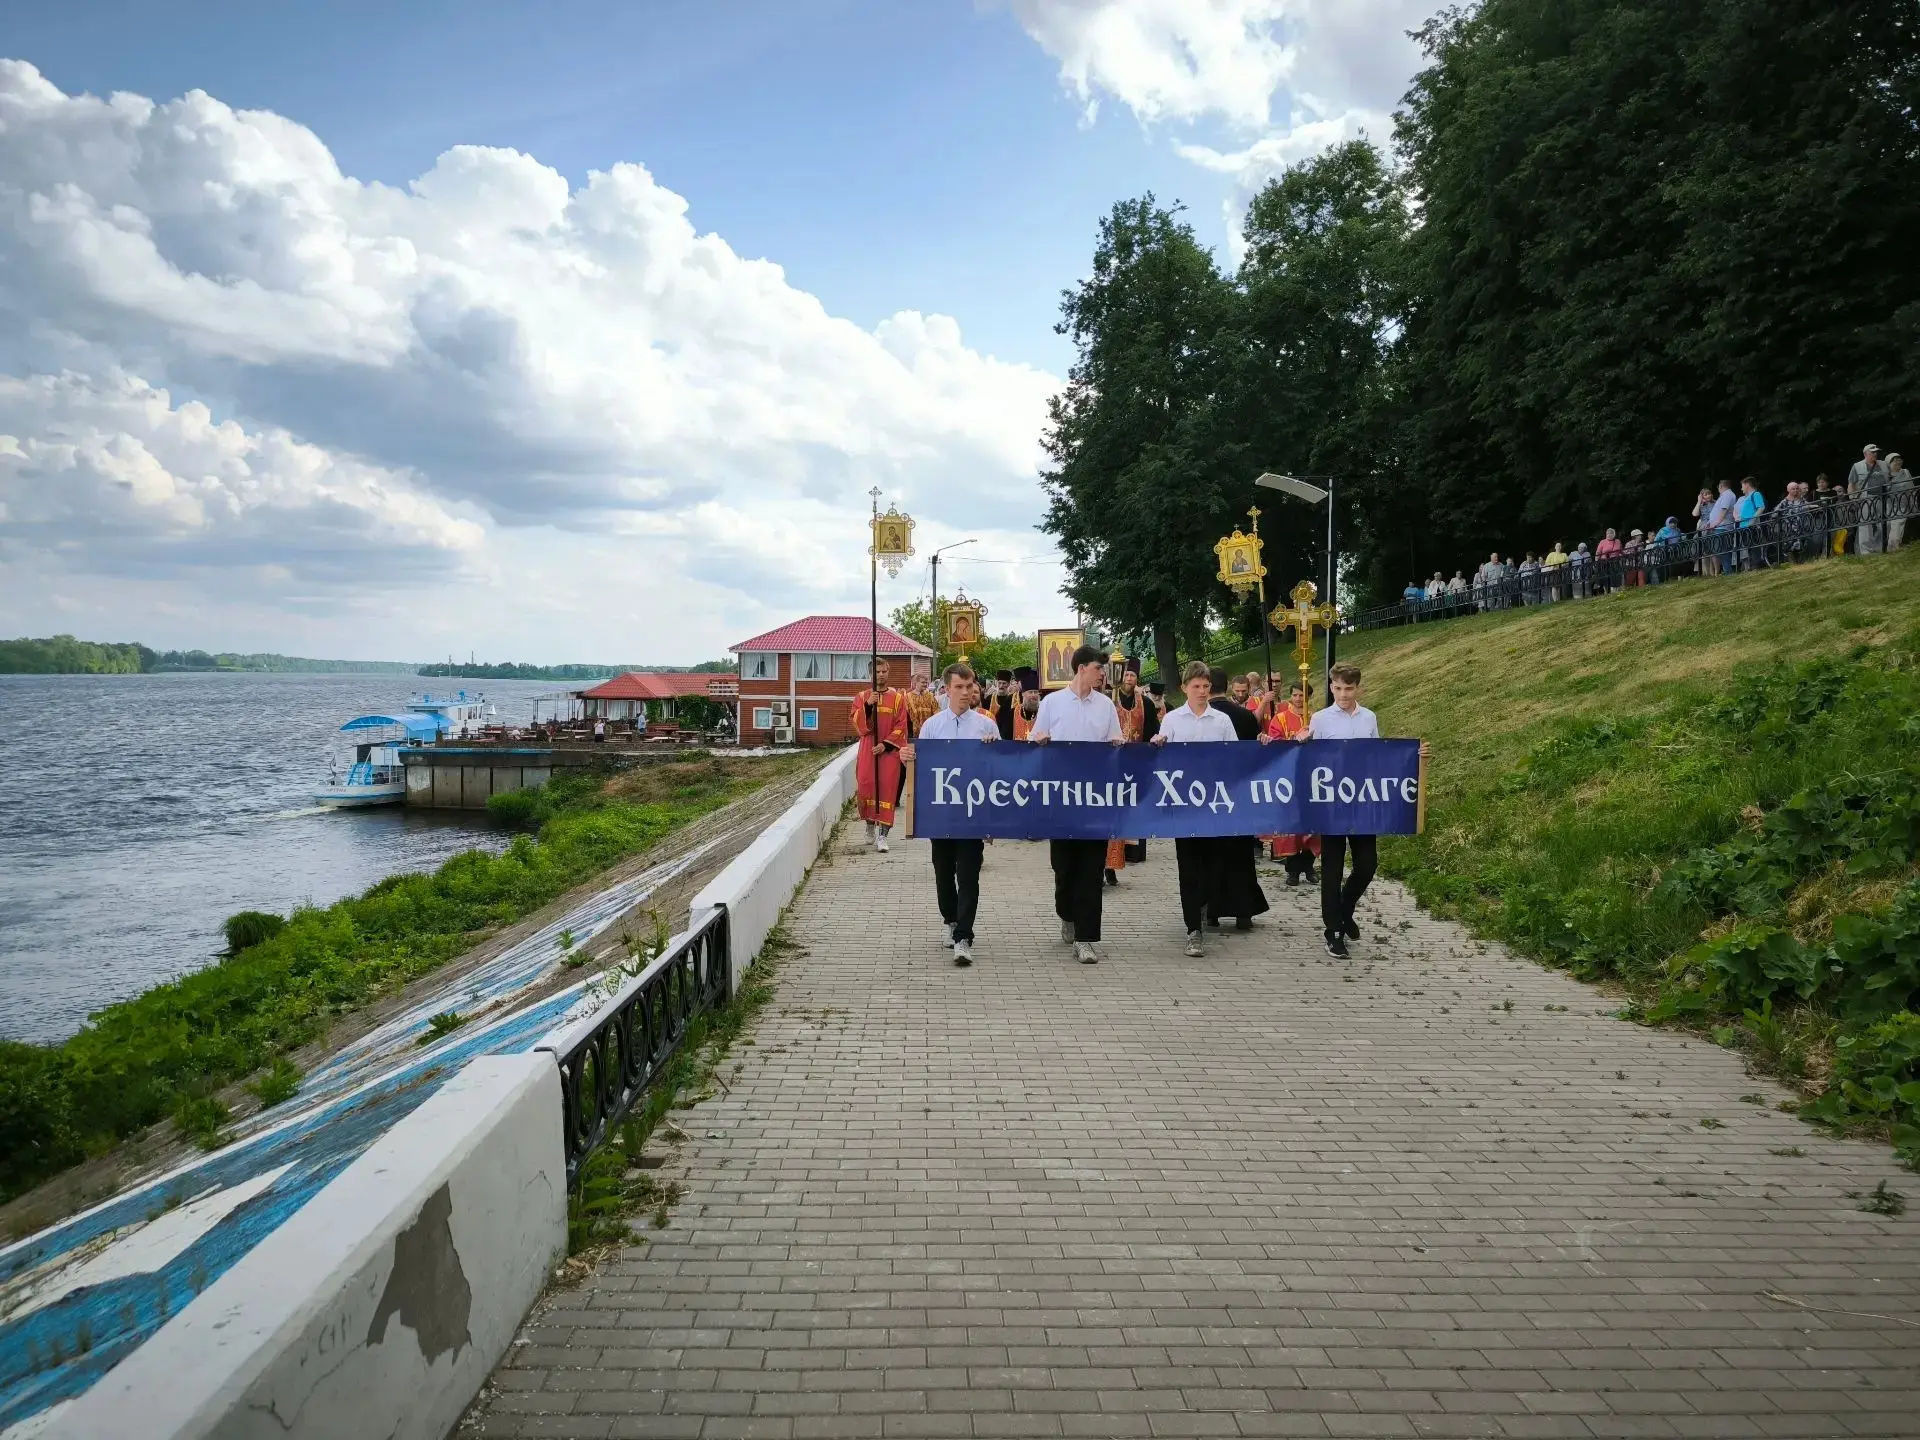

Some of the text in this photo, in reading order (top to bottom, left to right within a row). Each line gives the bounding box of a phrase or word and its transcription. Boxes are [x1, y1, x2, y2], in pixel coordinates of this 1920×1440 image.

[931, 766, 1418, 818] Крестный Ход по Волге
